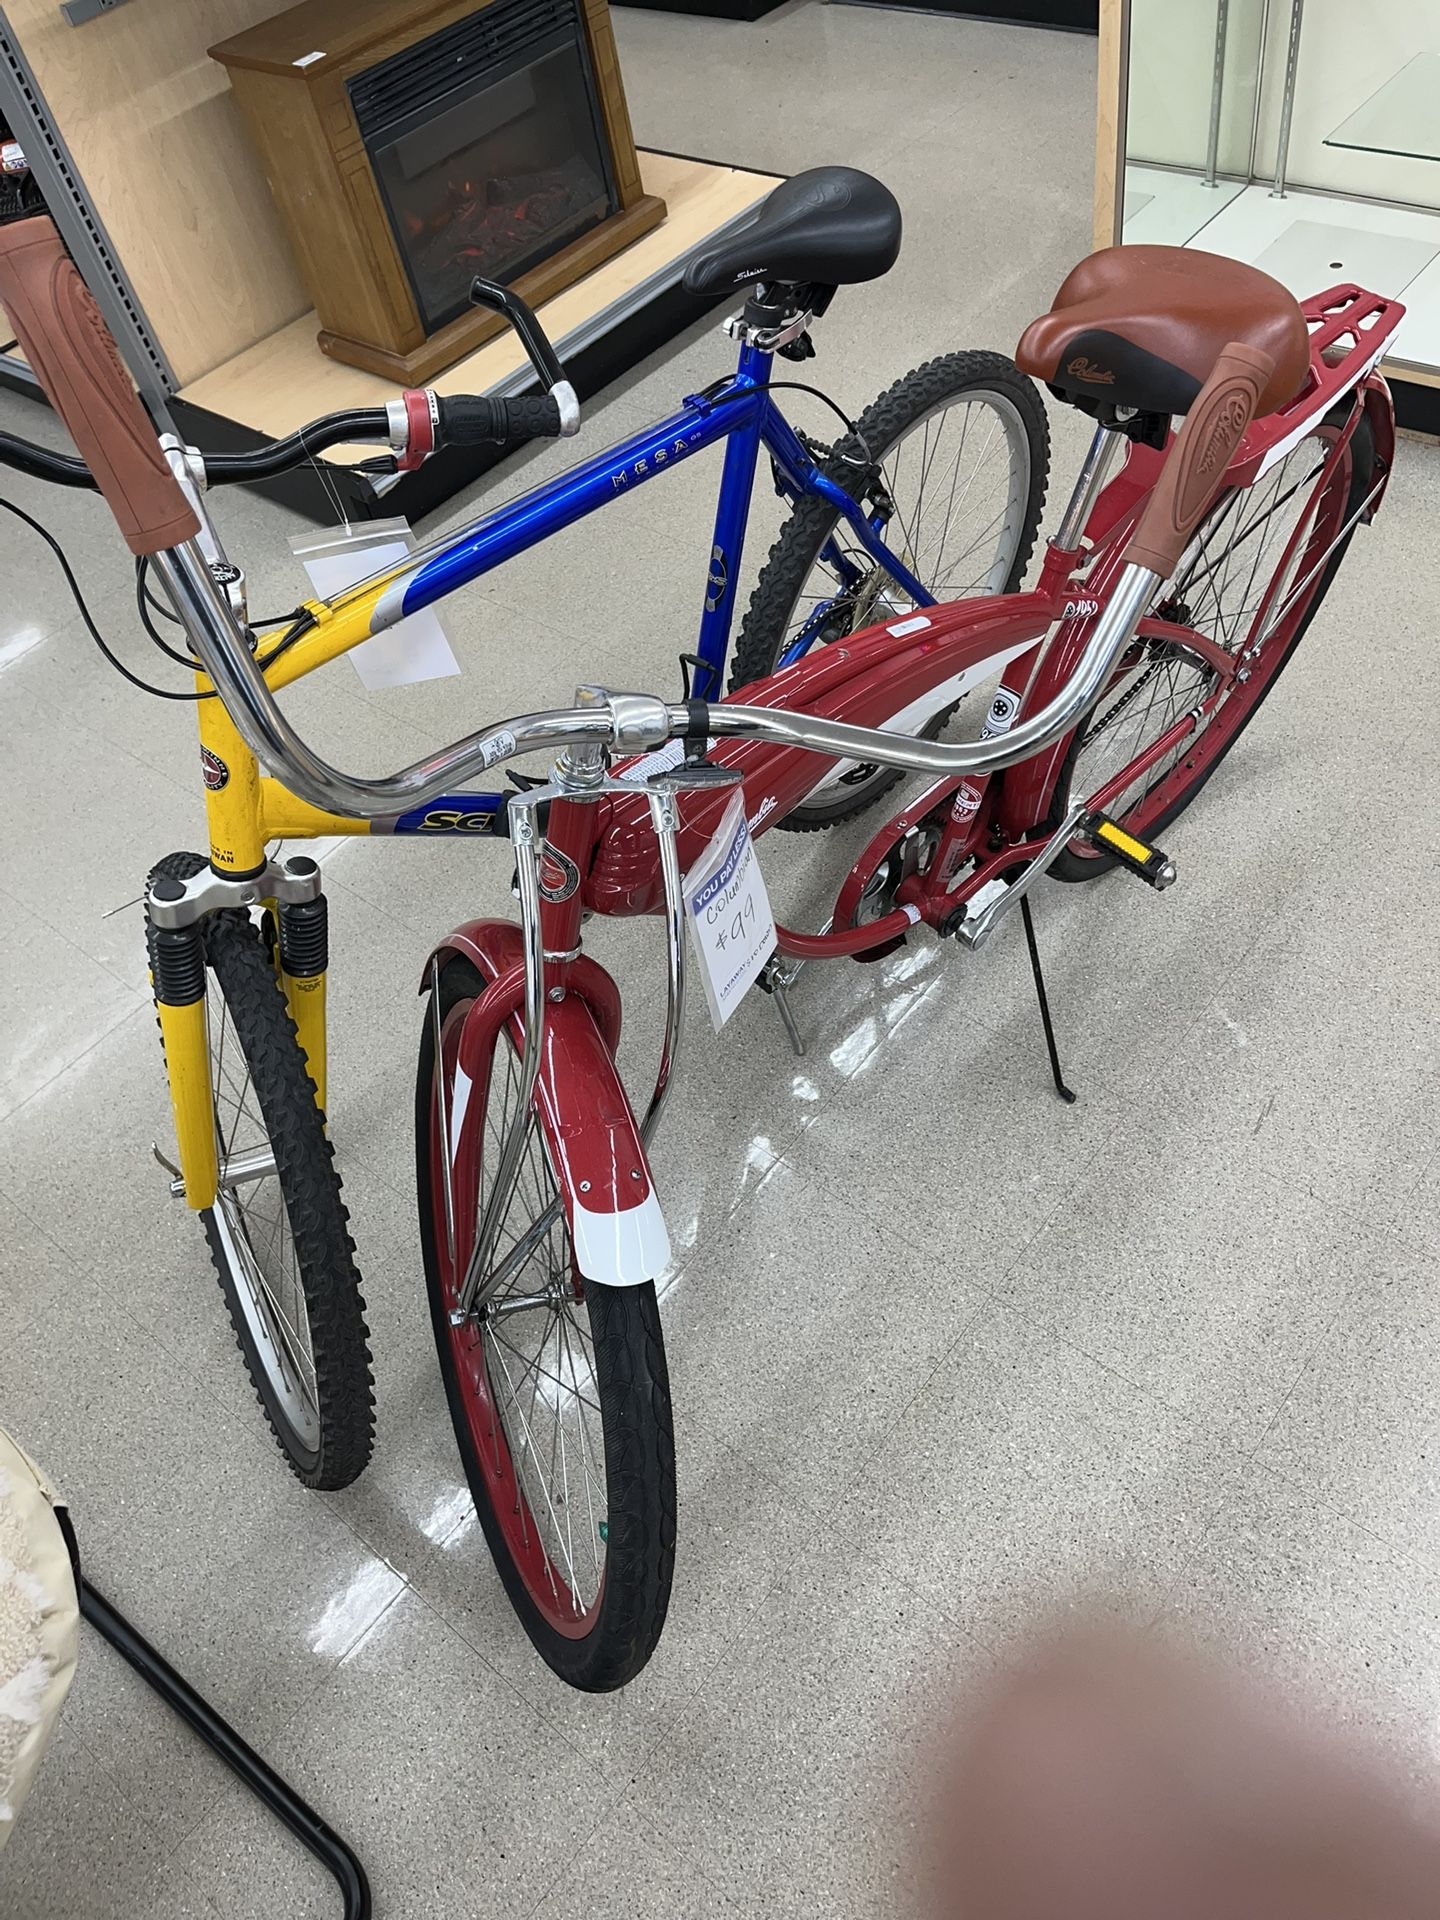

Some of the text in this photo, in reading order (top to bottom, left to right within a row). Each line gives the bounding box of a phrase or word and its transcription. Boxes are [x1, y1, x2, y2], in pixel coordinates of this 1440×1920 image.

[611, 438, 688, 488] MESA
[695, 825, 748, 907] YOU PAY LESS!
[714, 893, 756, 951] $99
[720, 963, 746, 998] LAYAWAY
